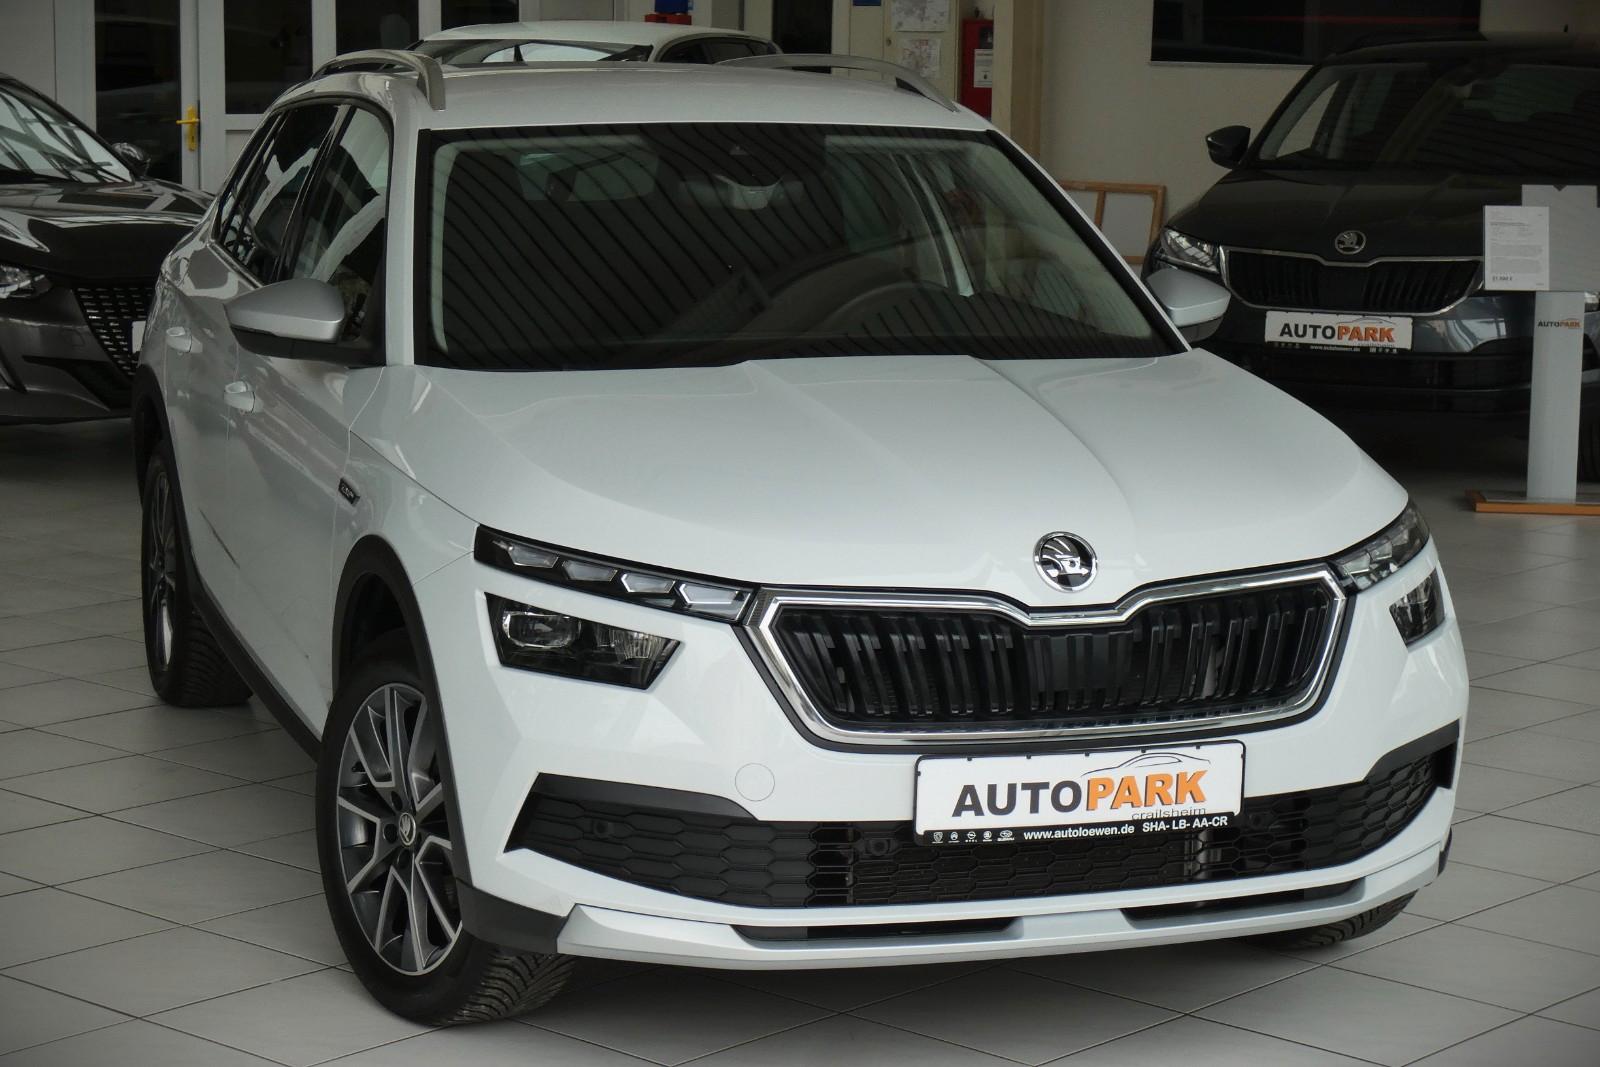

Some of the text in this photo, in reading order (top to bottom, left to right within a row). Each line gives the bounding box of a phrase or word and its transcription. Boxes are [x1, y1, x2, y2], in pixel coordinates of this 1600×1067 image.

[1280, 323, 1395, 342] AUTOPARK
[952, 770, 1207, 818] AUTOPARK
[1023, 823, 1135, 840] www.autoloewen.de
